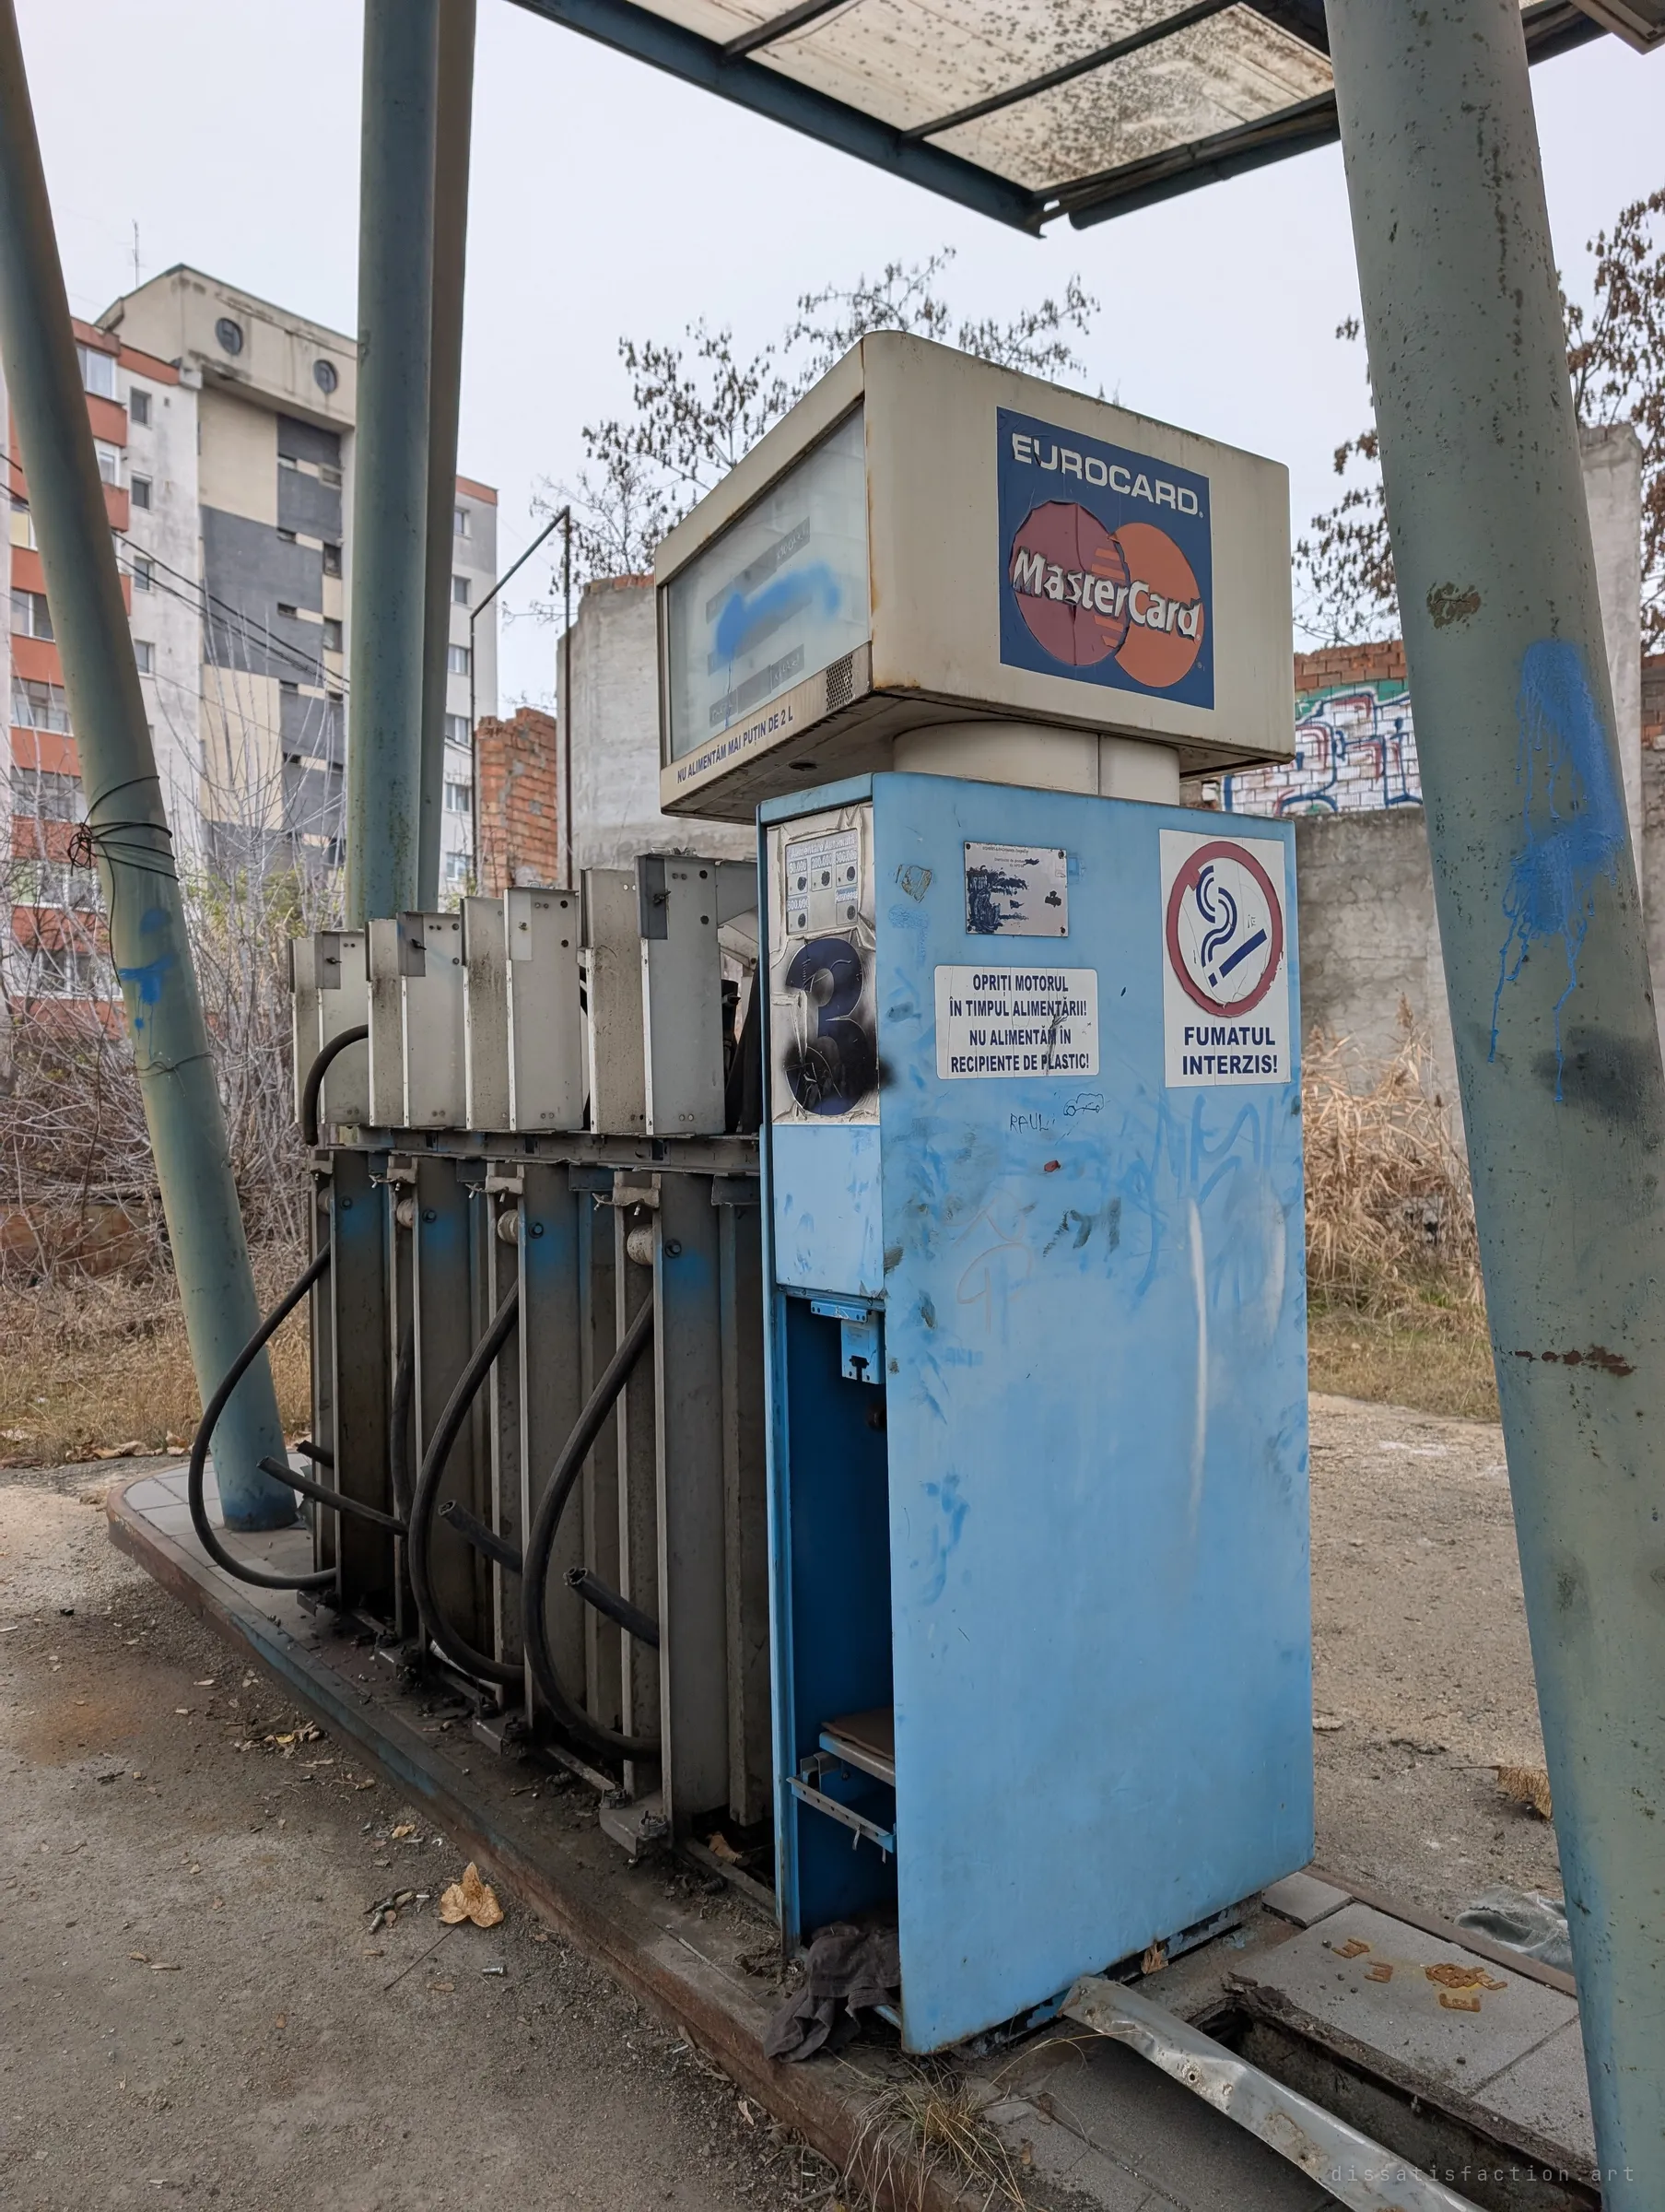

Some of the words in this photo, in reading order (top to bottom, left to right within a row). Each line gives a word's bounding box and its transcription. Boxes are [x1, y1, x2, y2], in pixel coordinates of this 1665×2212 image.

[1012, 432, 1198, 515] EUROCARD
[1012, 547, 1202, 639] MasterCard
[677, 767, 687, 783] NU
[728, 735, 742, 756] MAI
[768, 713, 779, 733] DE
[780, 709, 786, 726] 2
[788, 706, 793, 722] L
[973, 974, 1011, 997] OPRIȚI
[1015, 975, 1069, 992] MOTORUL
[949, 995, 962, 1017] ÎN
[966, 1000, 1010, 1017] TIMPUL
[1013, 996, 1087, 1017] ALIMENTĂRII!
[969, 1030, 986, 1046] NU
[990, 1025, 1057, 1046] ALIMENTĂM
[1060, 1025, 1072, 1045] ÎN
[1184, 1026, 1276, 1046] FUMATUL
[951, 1054, 1020, 1073] RECIPIENTE
[1024, 1054, 1038, 1071] DE
[1041, 1053, 1089, 1071] PLASTIC!
[1182, 1054, 1278, 1076] INTERZIS!
